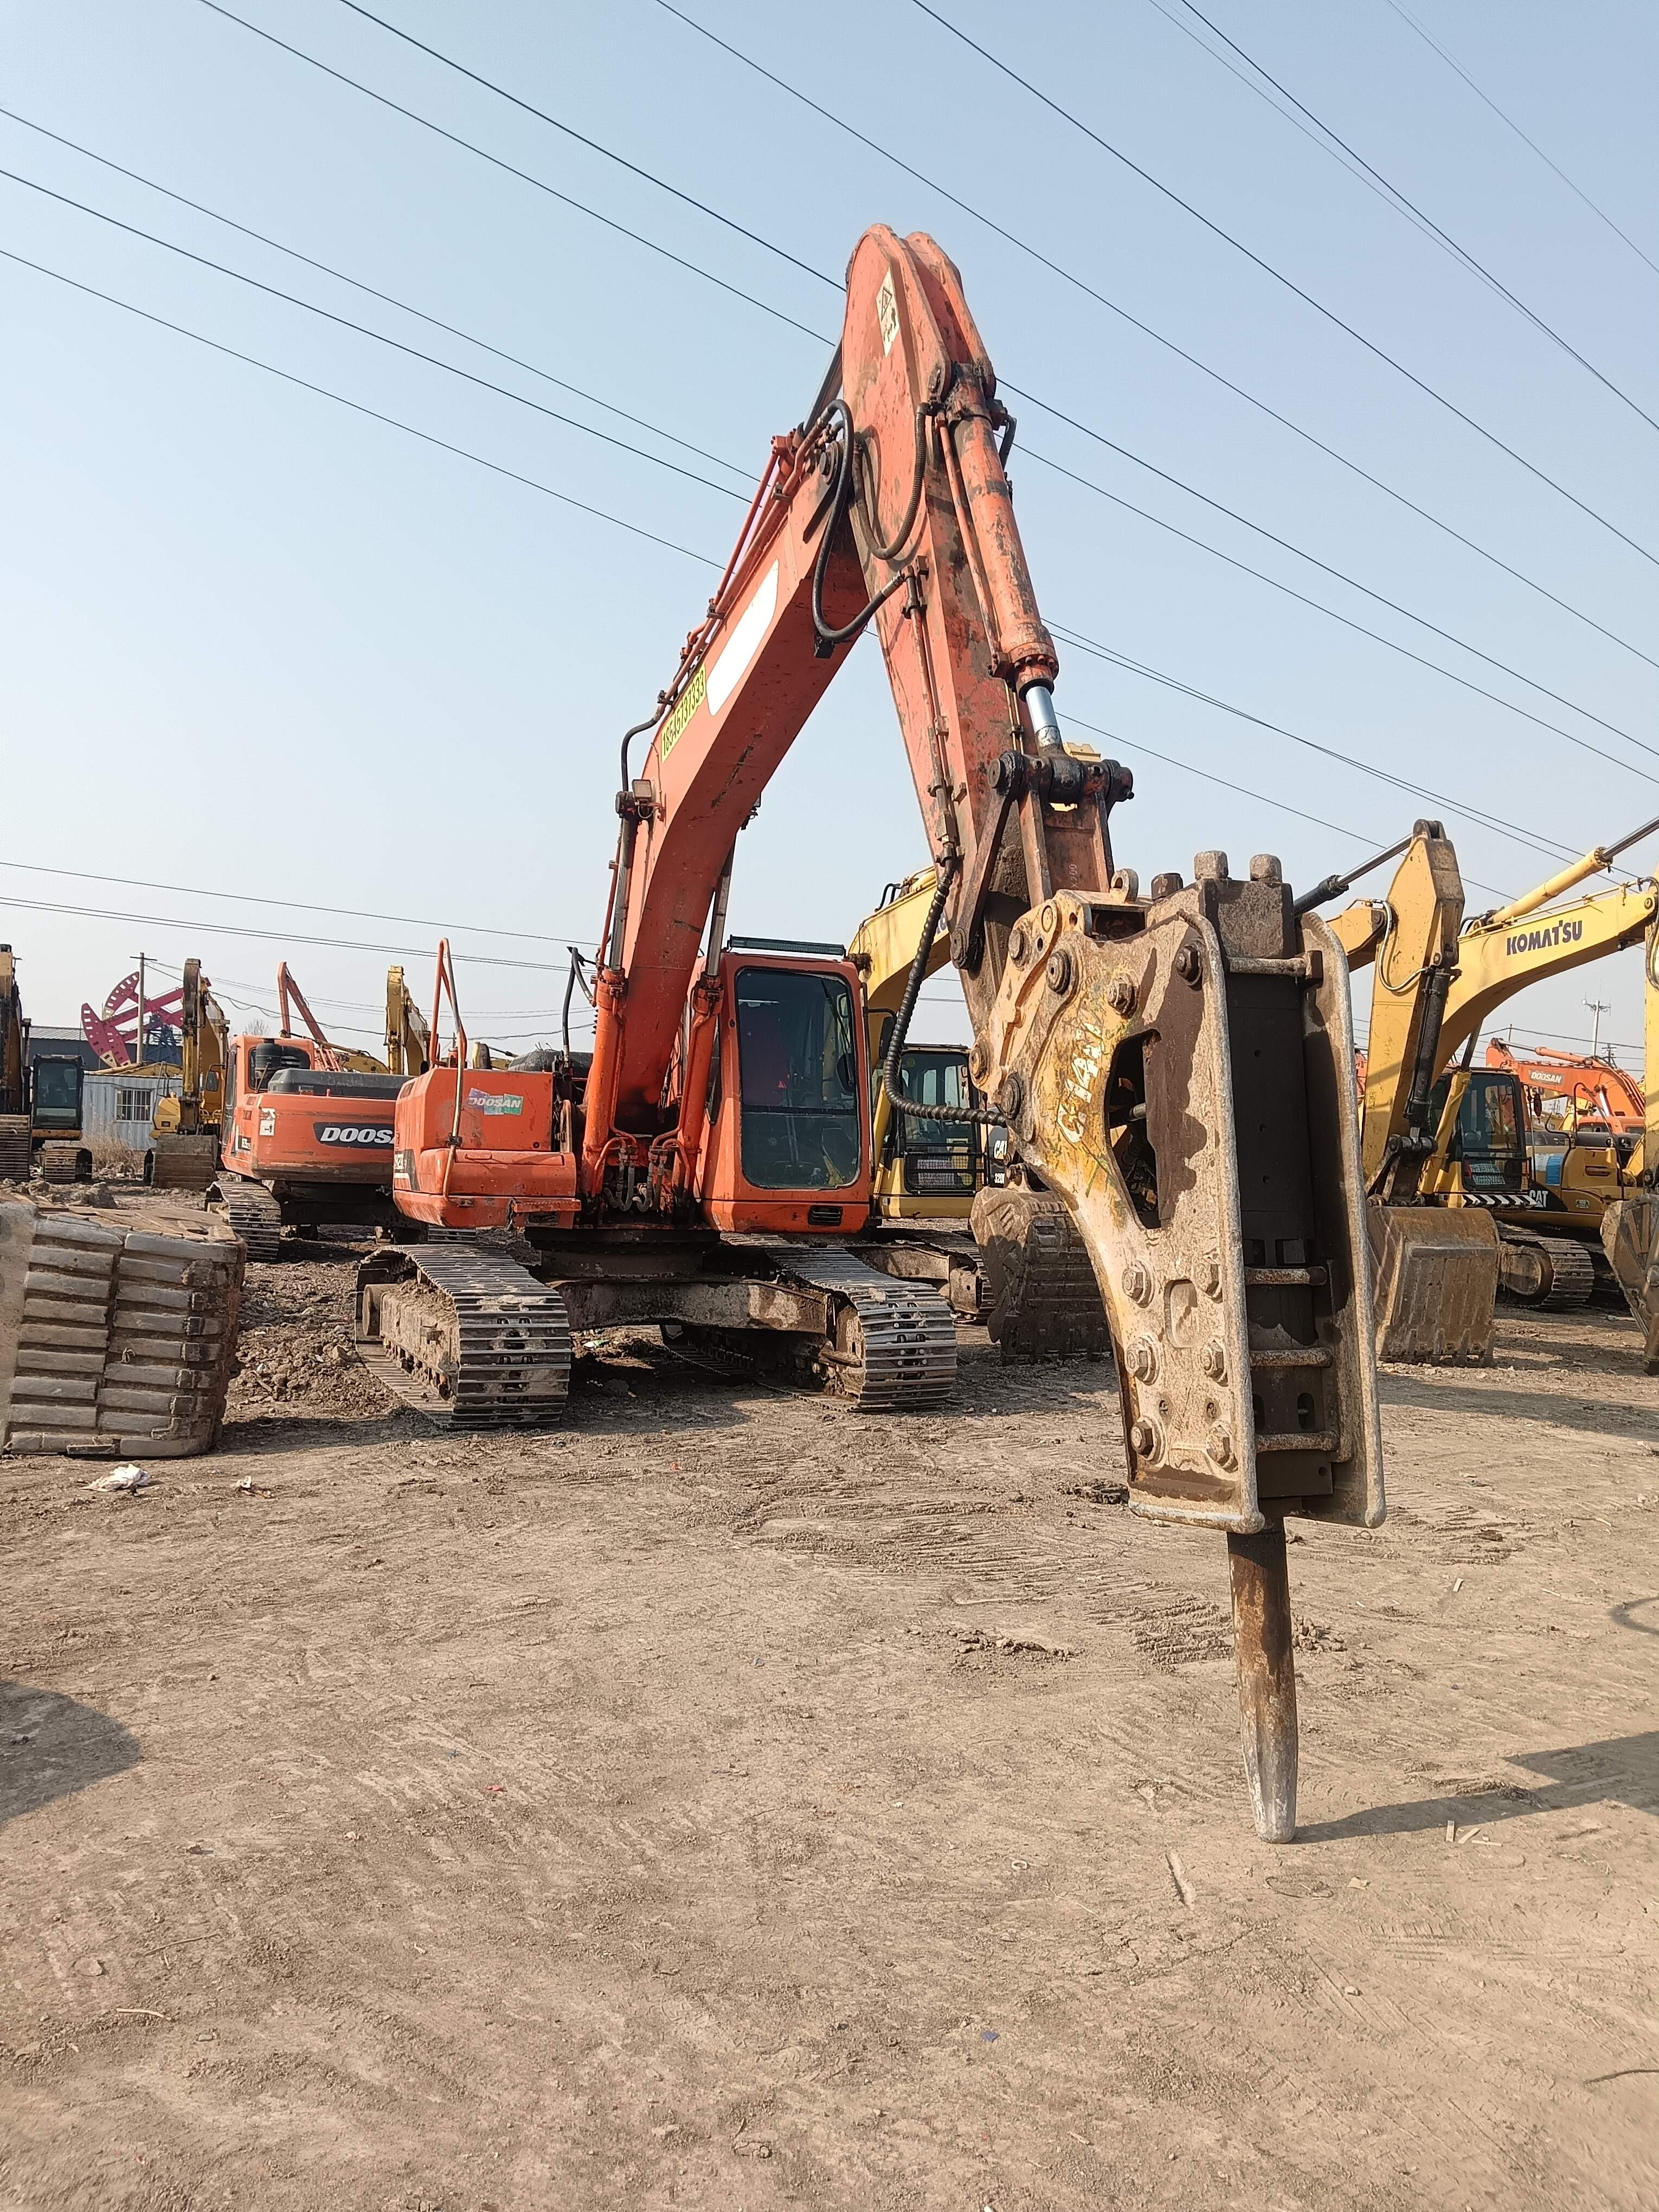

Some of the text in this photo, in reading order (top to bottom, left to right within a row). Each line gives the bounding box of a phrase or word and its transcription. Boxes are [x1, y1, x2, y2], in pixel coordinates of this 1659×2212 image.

[663, 670, 704, 756] 18545737333
[1507, 919, 1583, 955] KOMATSU
[1531, 1071, 1562, 1083] DOOSAN
[467, 1097, 522, 1108] DOOSAN
[320, 1127, 395, 1144] DOOS
